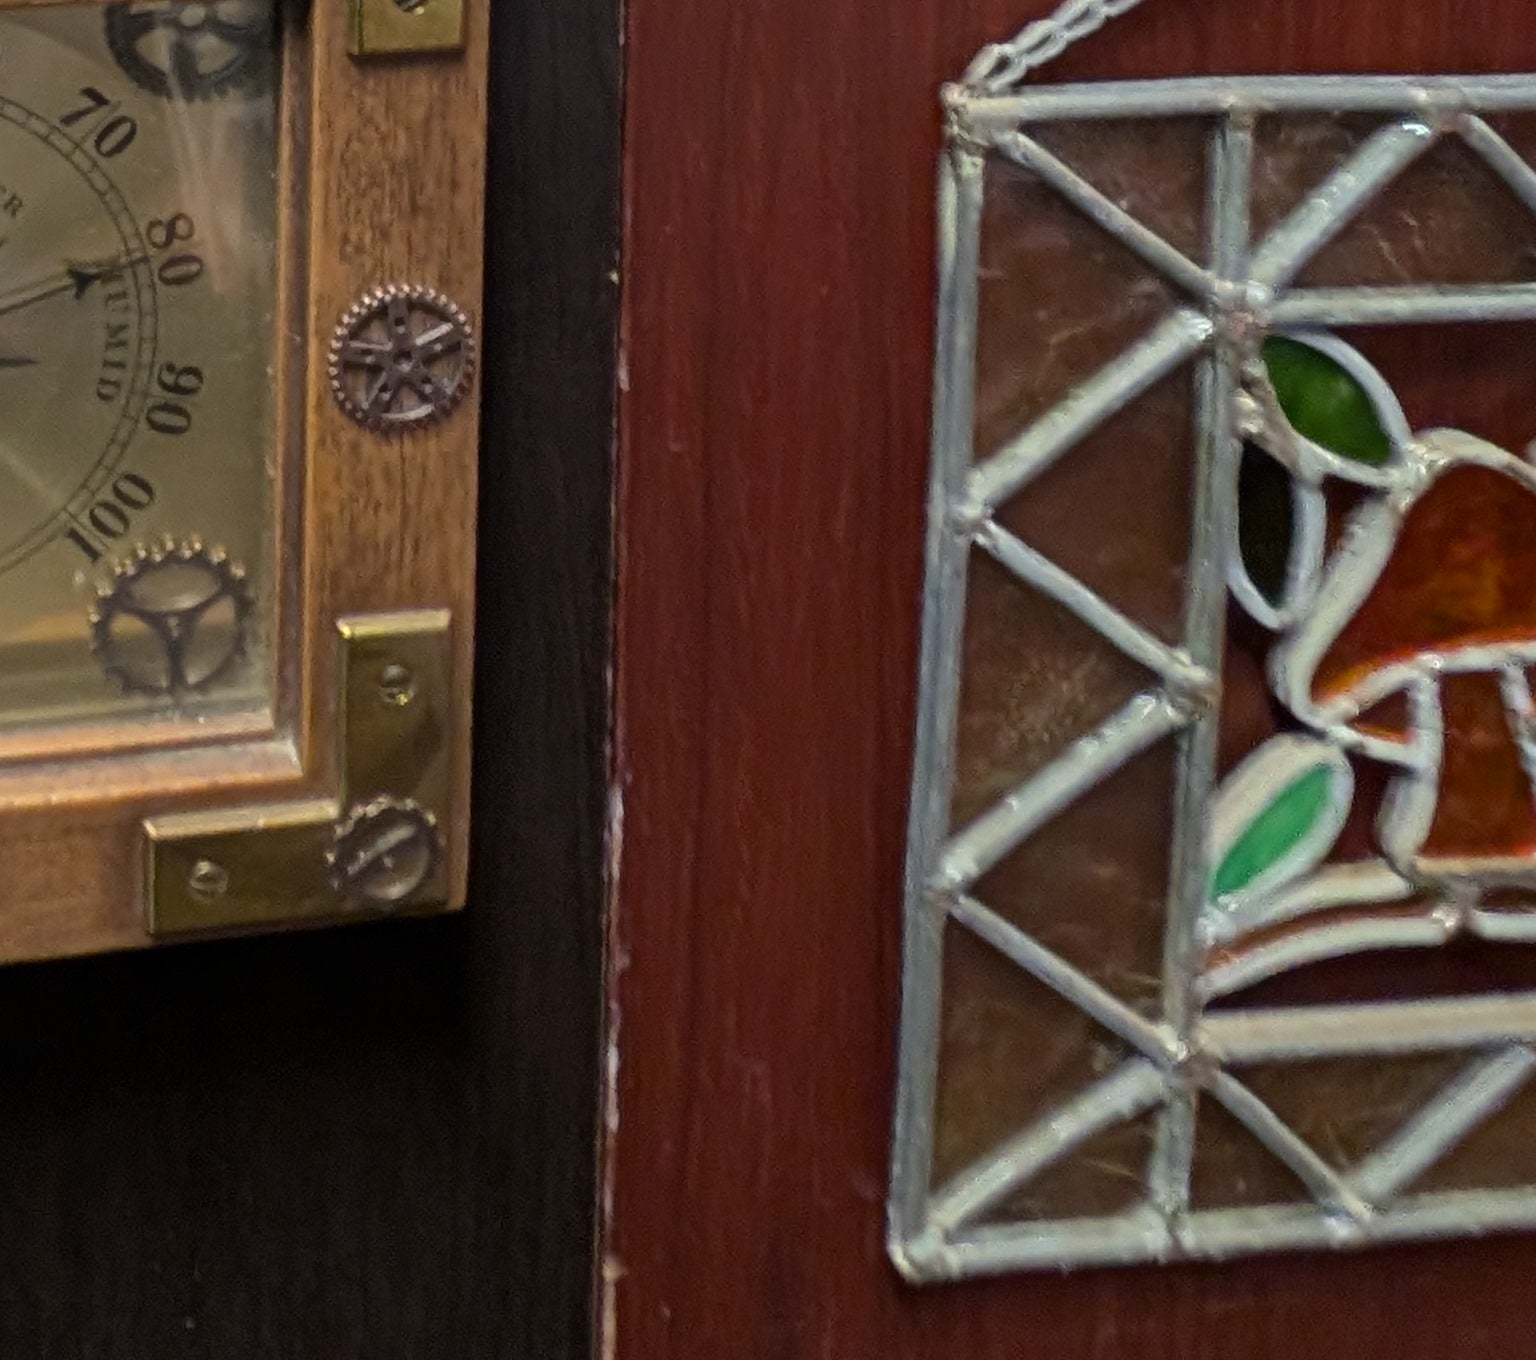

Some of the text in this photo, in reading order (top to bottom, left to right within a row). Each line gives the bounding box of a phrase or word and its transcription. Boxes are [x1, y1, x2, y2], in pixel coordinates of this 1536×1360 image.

[59, 87, 138, 159] 70
[146, 212, 205, 286] 80
[145, 361, 205, 436] 90
[65, 473, 156, 565] 100
